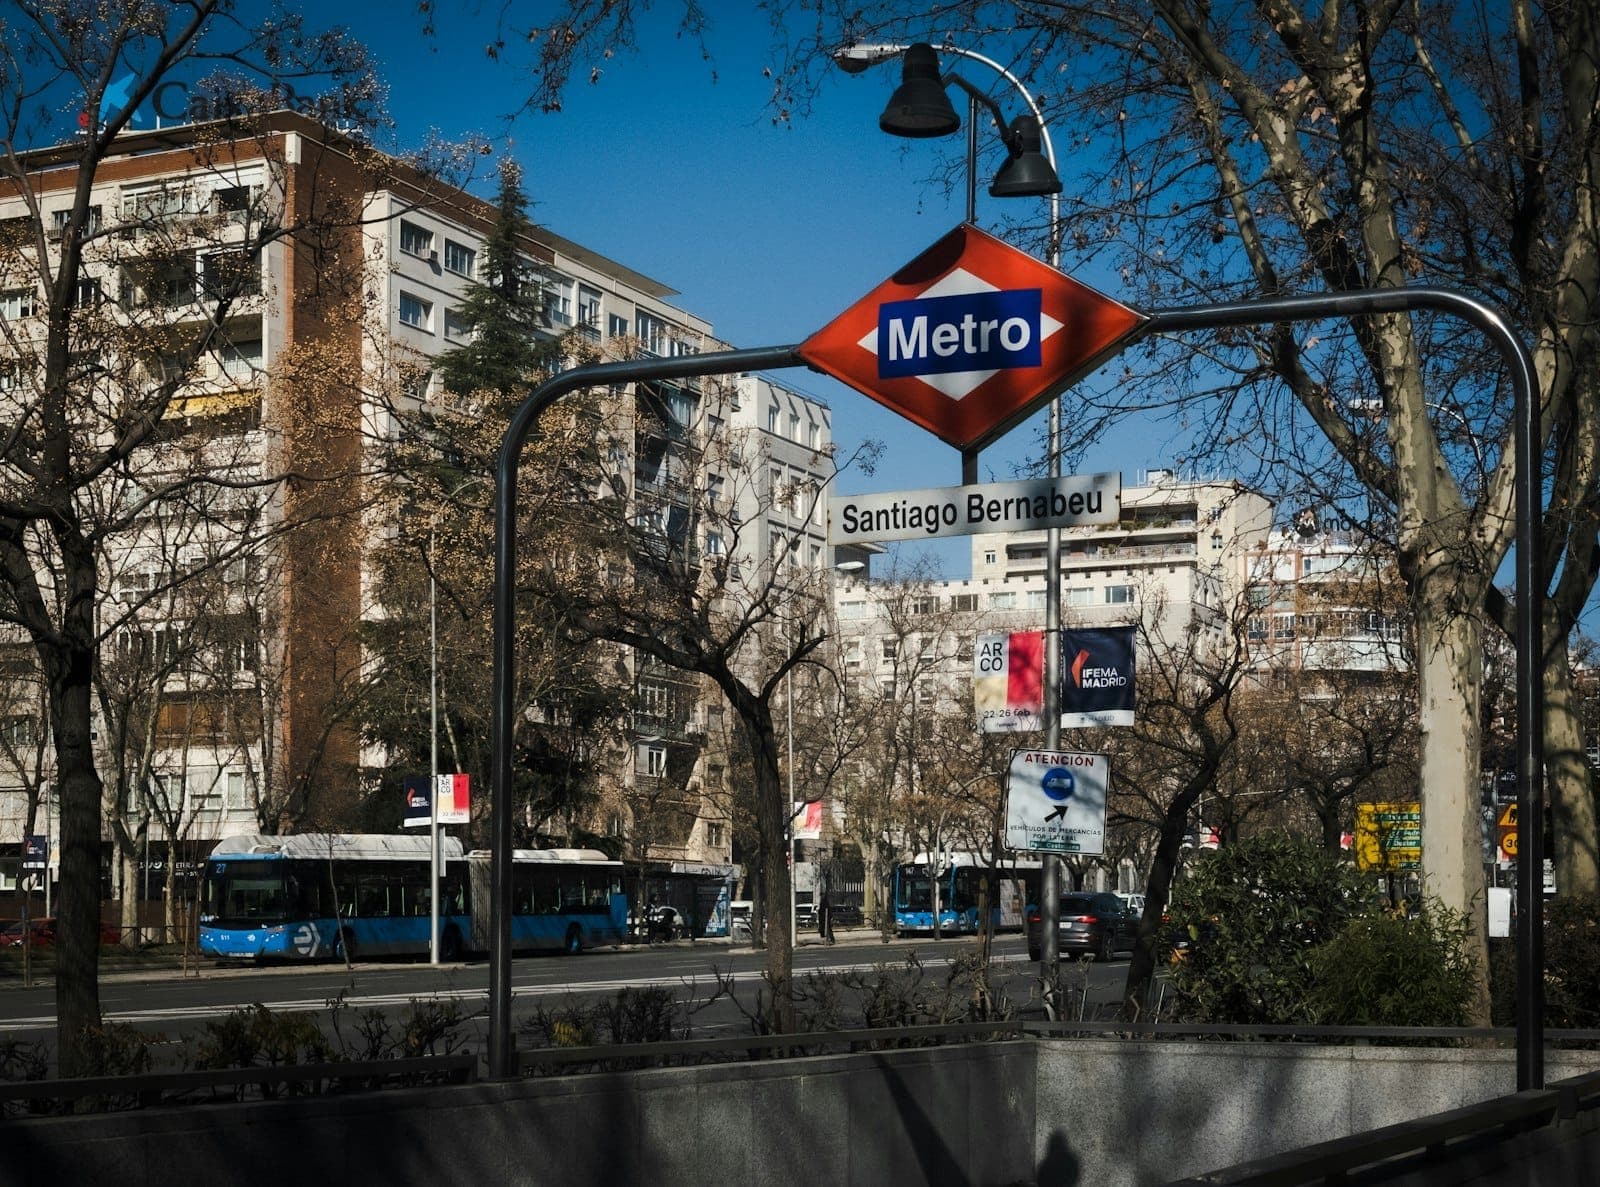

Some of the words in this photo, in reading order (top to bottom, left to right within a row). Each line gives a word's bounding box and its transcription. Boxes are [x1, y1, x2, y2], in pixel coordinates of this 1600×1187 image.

[888, 314, 1030, 361] Metro
[843, 500, 957, 534] Santiago
[967, 487, 1102, 524] Bernabeu
[980, 642, 1003, 656] AR
[980, 657, 1003, 672] CO
[1082, 667, 1117, 678] IFEMA
[1082, 677, 1127, 688] MADRID
[1024, 753, 1094, 767] ATENCIÓN
[215, 863, 227, 874] 27
